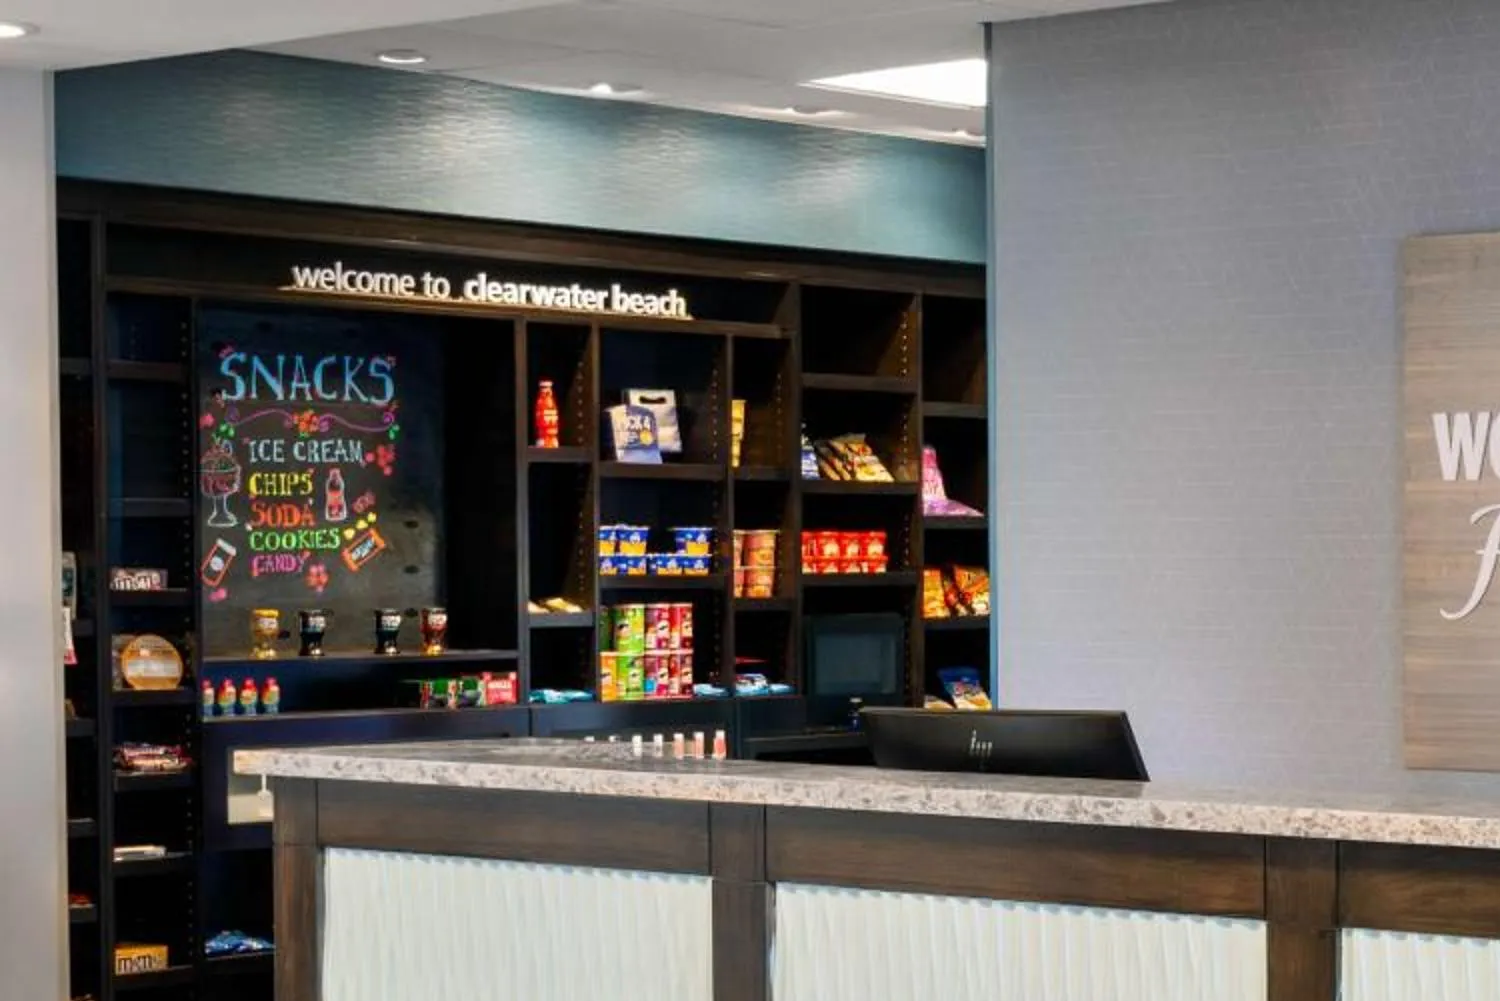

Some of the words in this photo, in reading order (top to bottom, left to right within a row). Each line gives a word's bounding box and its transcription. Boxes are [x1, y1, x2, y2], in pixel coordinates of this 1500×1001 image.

[291, 261, 415, 296] welcome
[421, 271, 450, 298] to
[463, 272, 609, 311] clearwater
[611, 283, 687, 318] beach
[219, 352, 395, 406] SNACKS
[249, 440, 285, 464] ICE
[293, 439, 364, 463] CREAM
[249, 472, 314, 496] CHIPS
[250, 502, 317, 529] SODA
[250, 528, 342, 551] COOKIES
[252, 553, 310, 576] CANDY
